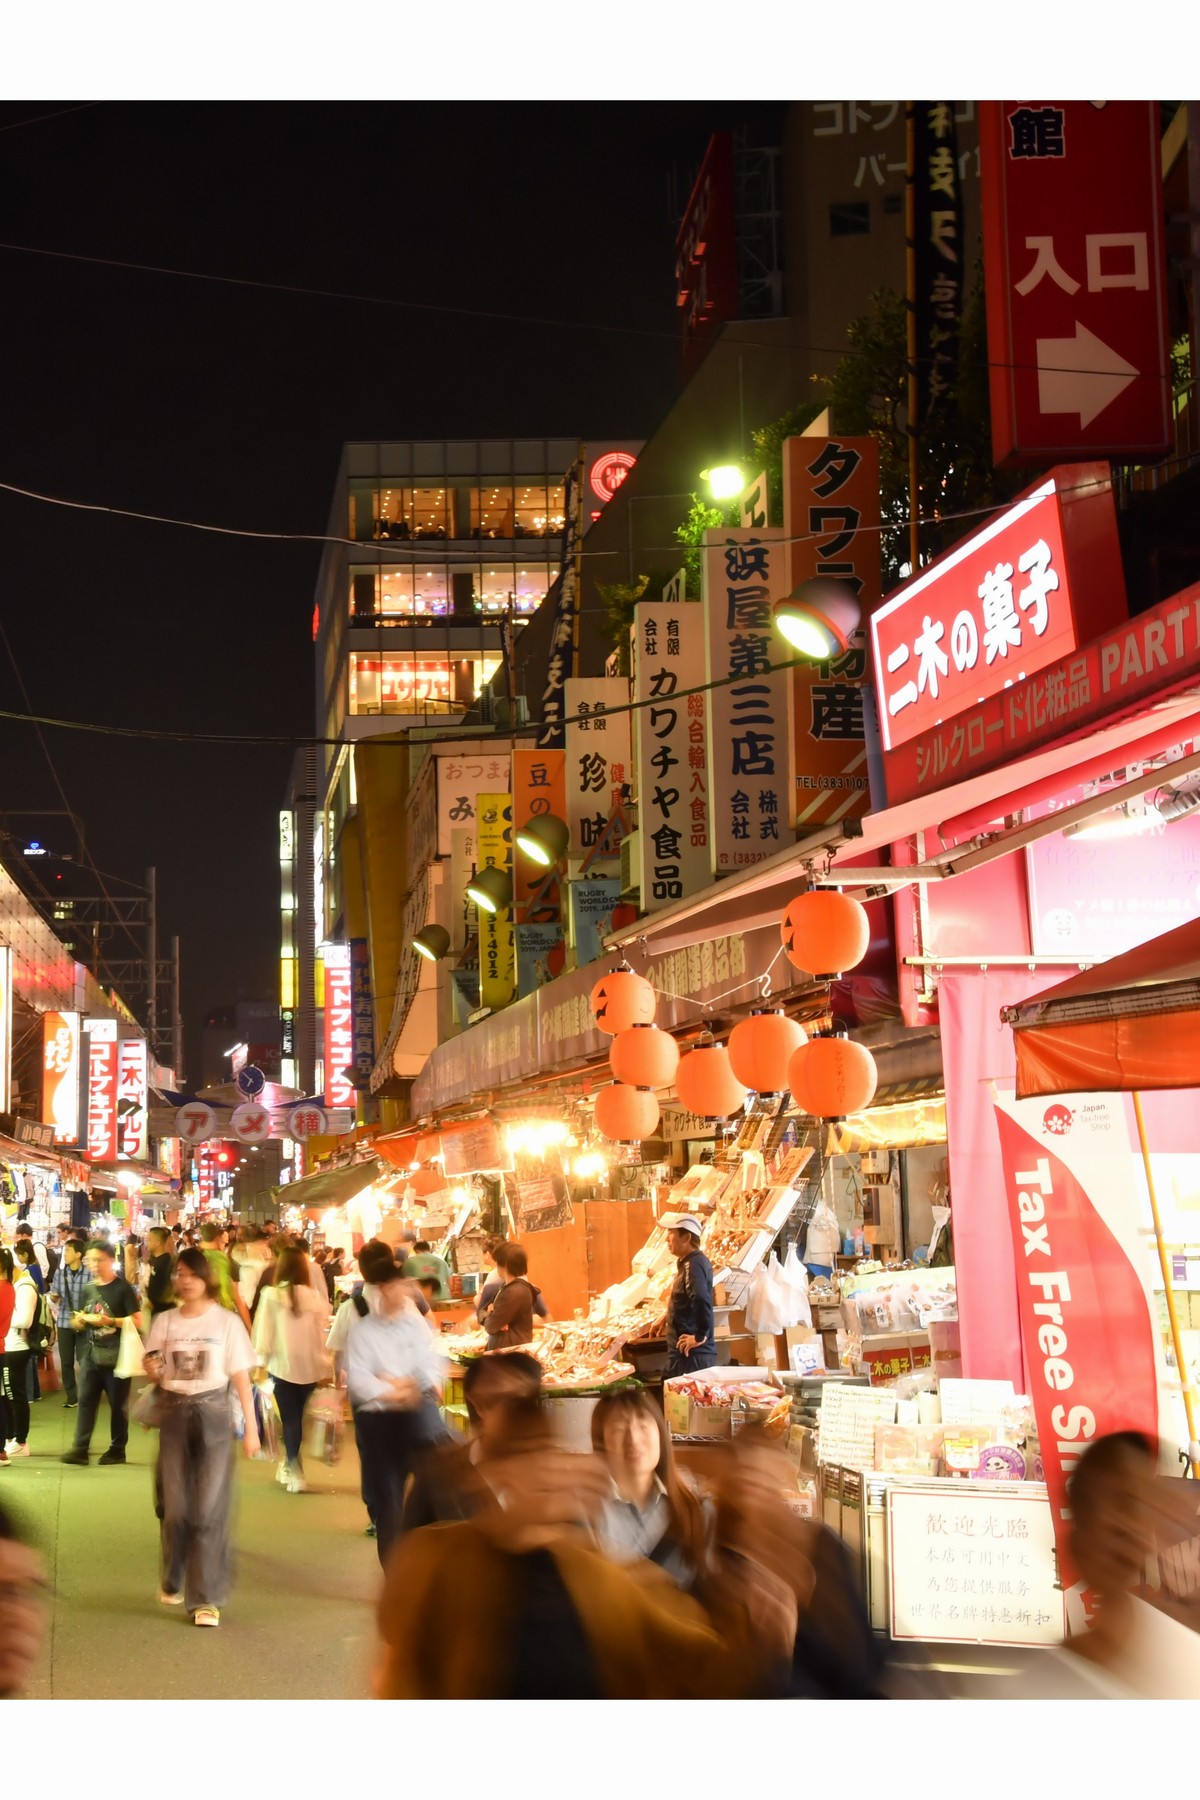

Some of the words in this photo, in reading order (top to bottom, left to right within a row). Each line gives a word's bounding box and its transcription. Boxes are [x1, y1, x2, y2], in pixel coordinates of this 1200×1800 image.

[1014, 232, 1150, 296] 入口
[644, 617, 657, 656] 会社
[667, 618, 680, 656] 有限
[724, 538, 775, 776] 浜屋第三店
[887, 538, 1059, 717] 二木の菓子
[916, 657, 1091, 783] シルクロード化粧品
[649, 666, 683, 900] カワチヤ食品
[687, 694, 707, 847] 総合輸入食品
[730, 790, 750, 840] 会社
[760, 790, 779, 840] 株式
[579, 897, 608, 905] WORLD
[183, 1110, 321, 1137] アメ横
[1015, 1158, 1054, 1257] Tax
[1029, 1271, 1075, 1391] Free
